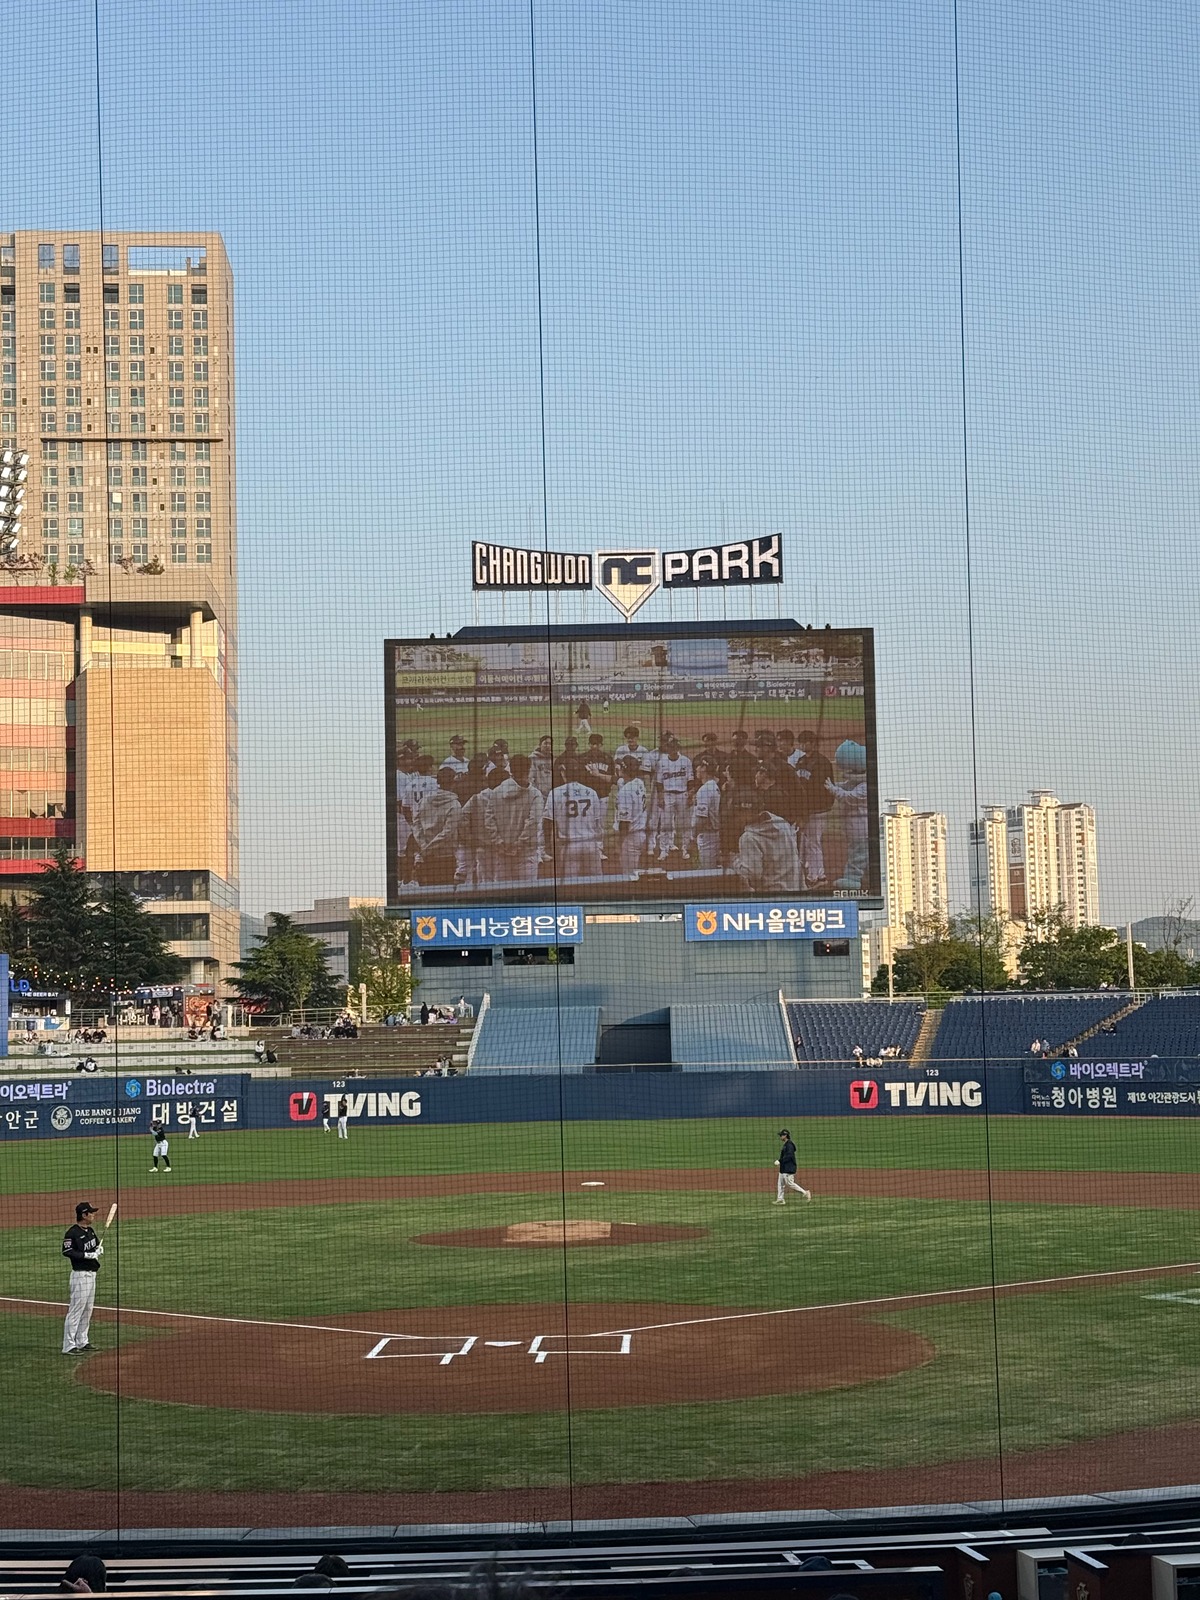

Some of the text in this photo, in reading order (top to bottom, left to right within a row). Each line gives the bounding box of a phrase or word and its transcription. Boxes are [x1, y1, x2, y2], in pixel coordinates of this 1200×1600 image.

[475, 543, 590, 585] CHANGWON
[665, 535, 780, 582] PARK
[565, 798, 592, 818] 37
[442, 915, 578, 938] NH농협은행
[723, 908, 846, 933] NH올원뱅크
[926, 1069, 939, 1077] 123
[1069, 1062, 1144, 1079] 바이오렉트라
[146, 1079, 215, 1096] Biolectra
[884, 1081, 982, 1107] TVING
[324, 1091, 421, 1117] TVING
[1127, 1091, 1147, 1104] 제1호
[1148, 1091, 1196, 1105] 야간관광도시
[0, 1110, 39, 1130] 안군
[75, 1109, 90, 1117] DAE
[91, 1108, 111, 1117] BANG
[123, 1107, 141, 1115] JANG
[152, 1100, 238, 1125] 대방건설
